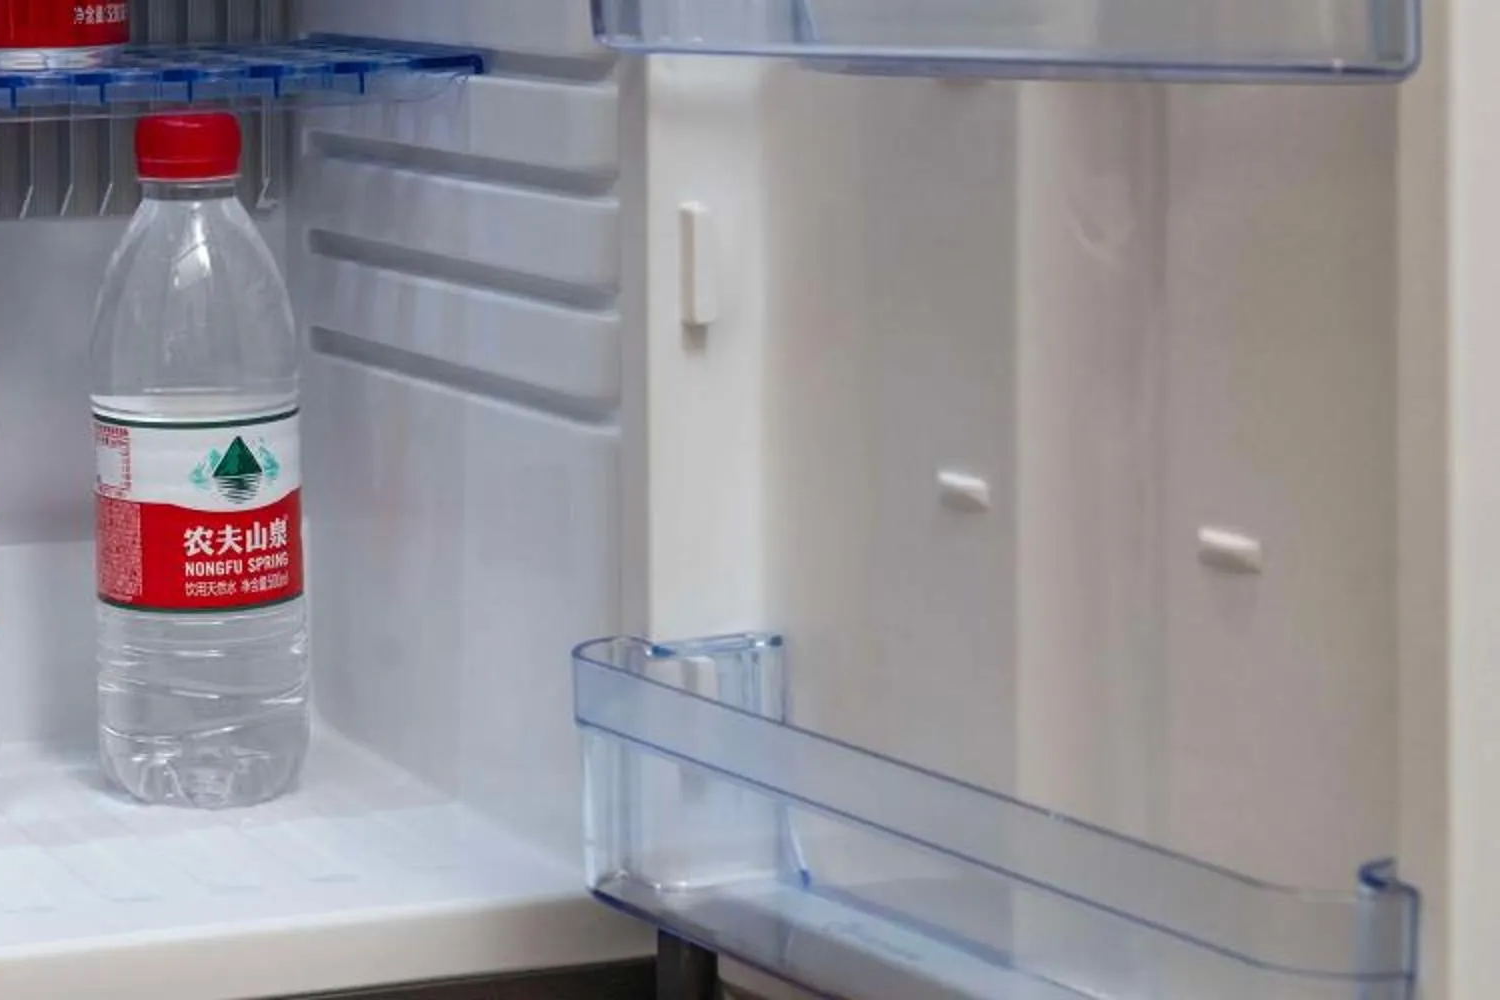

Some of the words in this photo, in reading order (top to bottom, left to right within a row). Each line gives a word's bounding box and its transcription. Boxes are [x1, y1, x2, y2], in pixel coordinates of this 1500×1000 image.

[183, 517, 287, 557] 农夫山泉
[185, 559, 243, 577] NONGFU
[247, 551, 289, 573] SPRING
